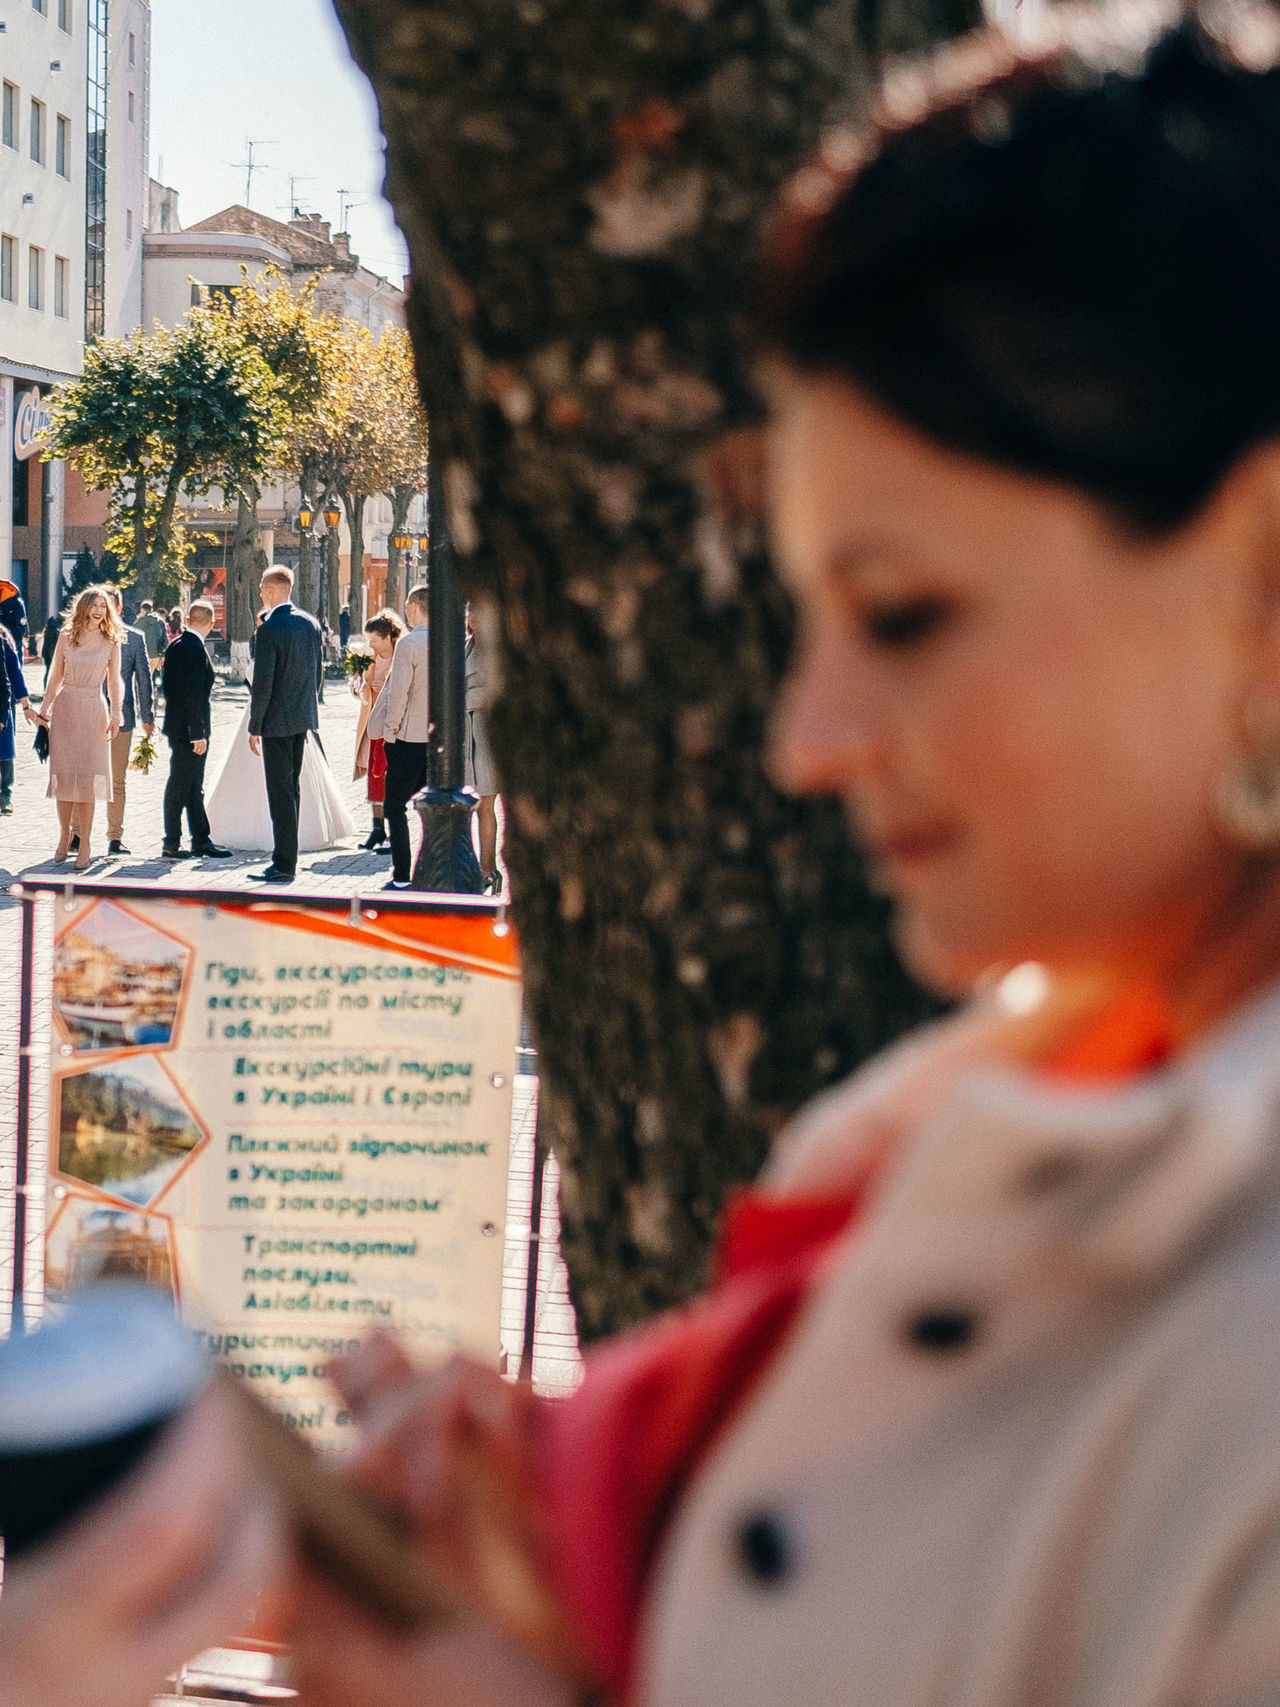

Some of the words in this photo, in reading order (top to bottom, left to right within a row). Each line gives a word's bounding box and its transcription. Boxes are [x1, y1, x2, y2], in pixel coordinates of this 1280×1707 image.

[207, 989, 330, 1014] екскурсії
[337, 995, 369, 1010] по
[382, 991, 463, 1015] місту
[224, 1019, 333, 1039] області
[234, 1056, 389, 1080] Екскурсійні
[400, 1061, 472, 1081] тури
[262, 1085, 354, 1108] Україні
[383, 1086, 472, 1112] Європі
[228, 1134, 338, 1153] Пляжний
[350, 1134, 489, 1158] відпочинок
[251, 1163, 343, 1187] Україні
[228, 1197, 265, 1210] та
[244, 1234, 417, 1264] Транспортні
[245, 1290, 393, 1316] Авіабілети
